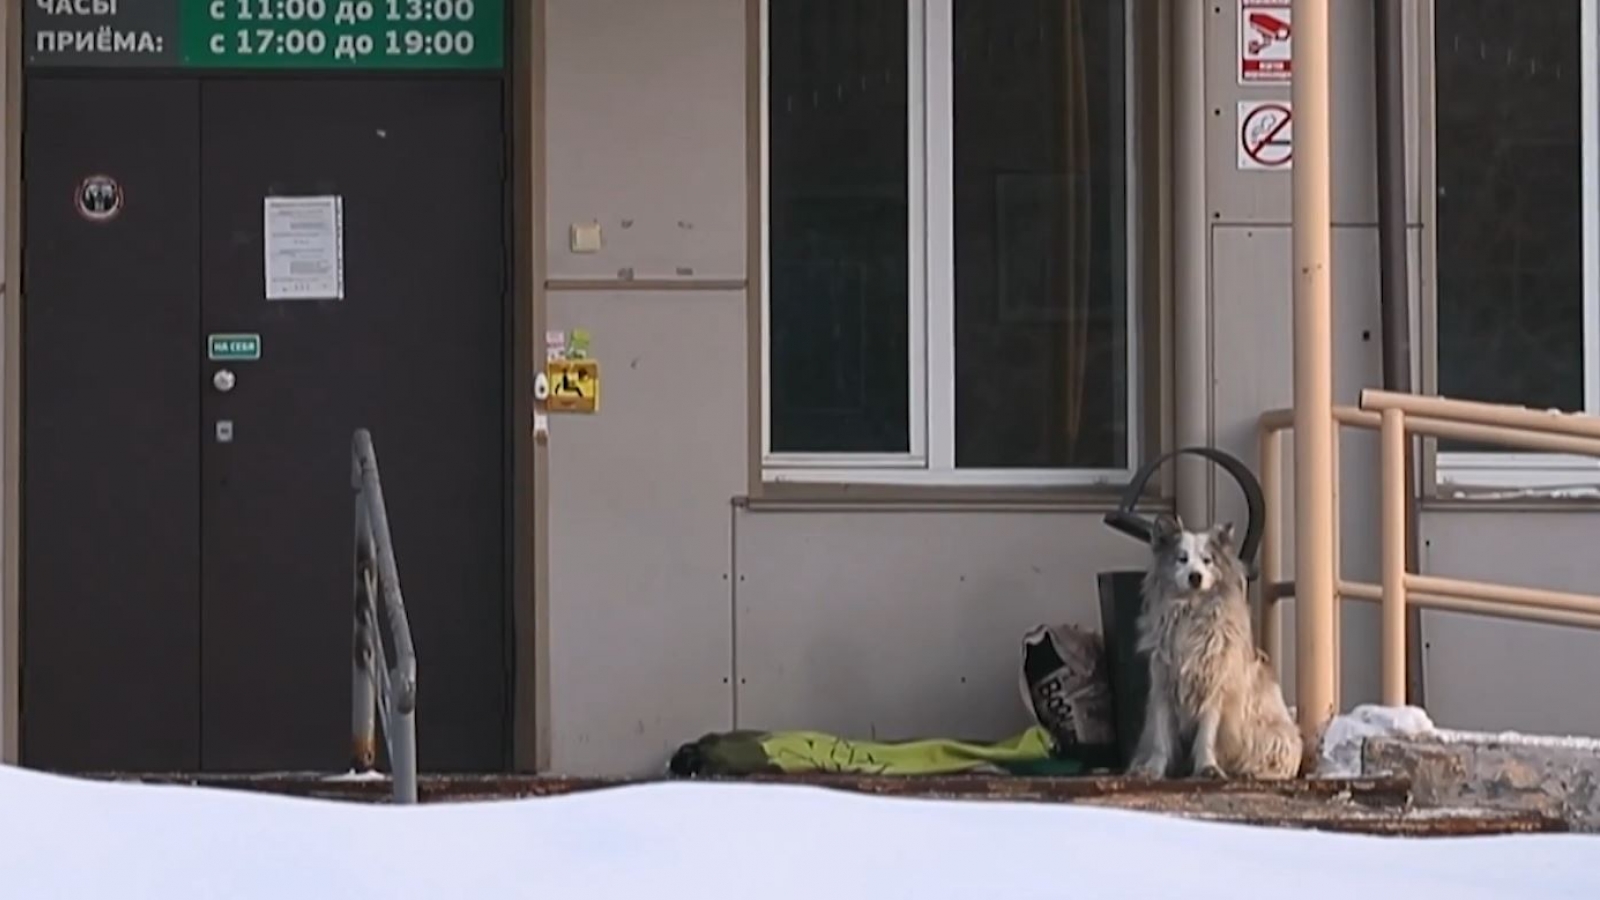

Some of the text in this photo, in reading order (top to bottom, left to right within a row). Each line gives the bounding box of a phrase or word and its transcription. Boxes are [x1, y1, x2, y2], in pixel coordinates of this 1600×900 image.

[37, 0, 117, 15] ЧАСЫ
[237, 0, 326, 20] 11:00
[334, 1, 373, 25] до
[386, 0, 475, 20] 13:00
[36, 25, 163, 52] ПРИЁМА:
[210, 29, 475, 59] с 17:00 до 19:00
